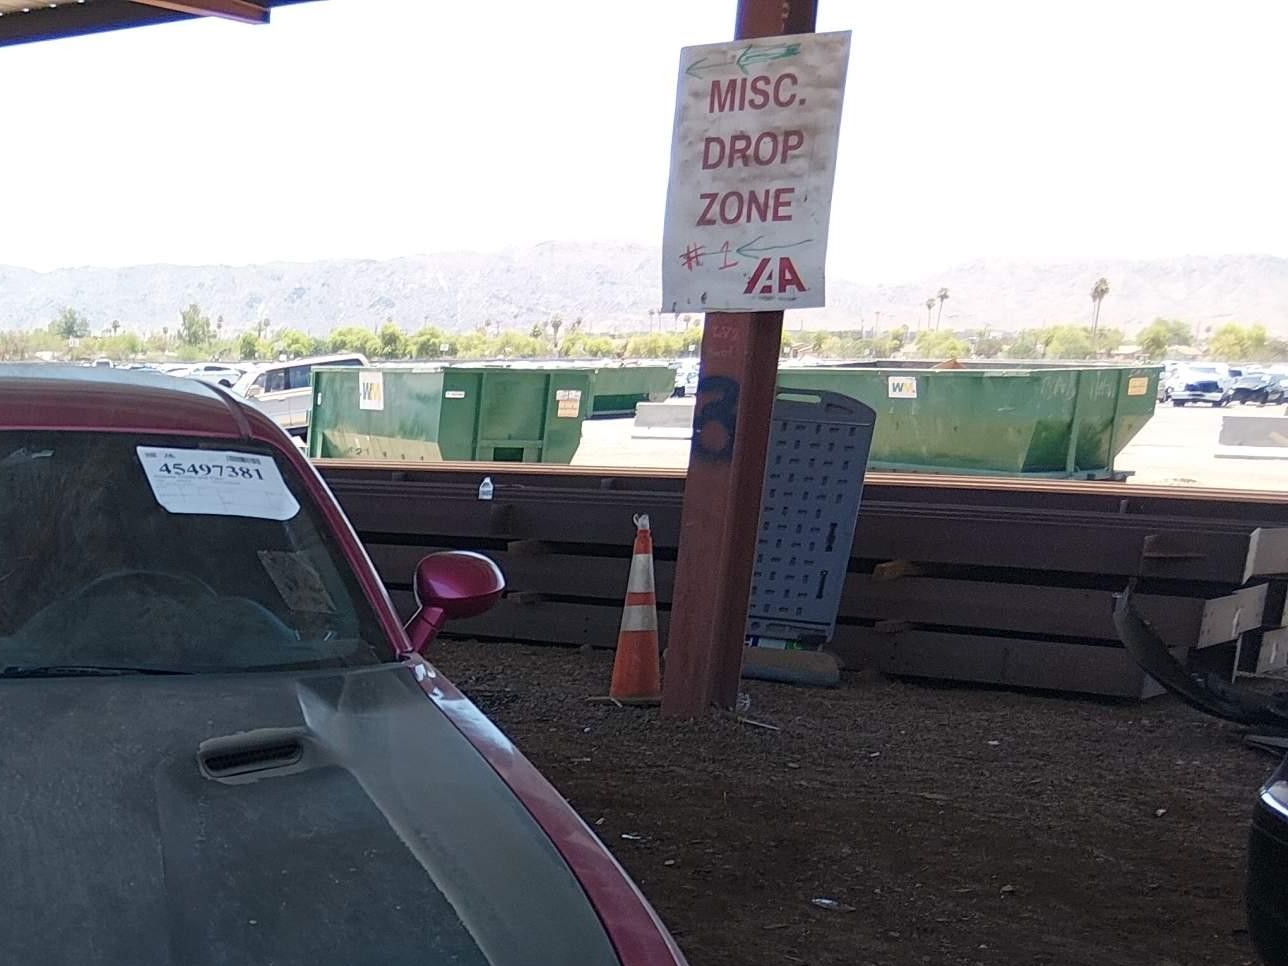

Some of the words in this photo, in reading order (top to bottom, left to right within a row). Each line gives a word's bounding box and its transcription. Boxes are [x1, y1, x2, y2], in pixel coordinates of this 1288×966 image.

[709, 73, 807, 113] MISC.
[702, 130, 805, 170] DROP
[696, 187, 795, 227] ZONE
[159, 462, 264, 481] 45497381
